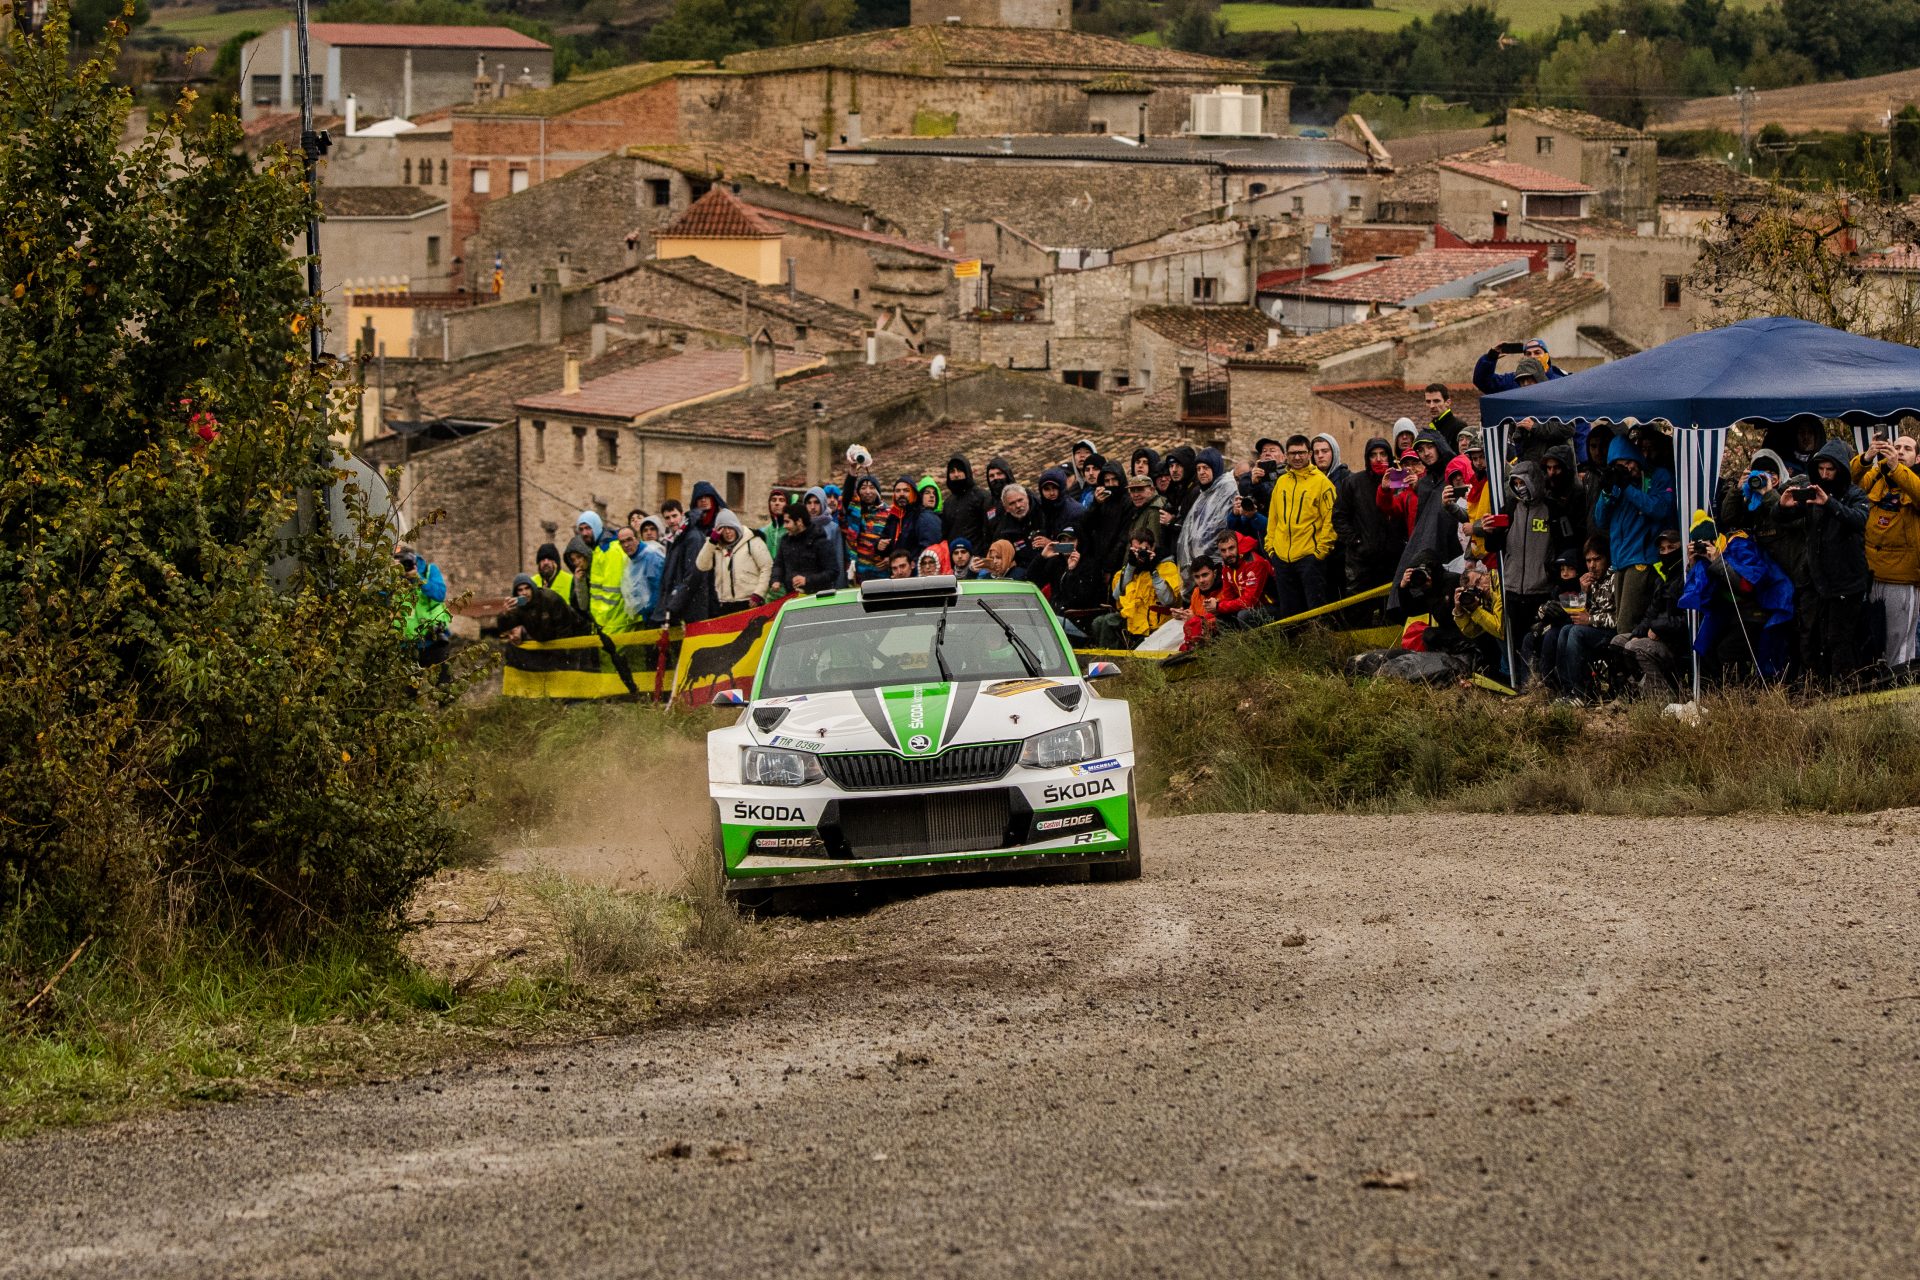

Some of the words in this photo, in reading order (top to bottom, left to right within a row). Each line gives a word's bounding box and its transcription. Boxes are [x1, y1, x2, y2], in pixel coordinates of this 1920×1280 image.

[908, 704, 924, 729] ŠKODA
[795, 740, 820, 751] 0390
[1087, 761, 1119, 770] MICHELIN
[1043, 778, 1116, 804] ŠKODA
[734, 800, 806, 822] ŠKODA
[1062, 814, 1094, 827] EDGE
[779, 837, 812, 847] EDGE
[1074, 830, 1108, 844] R5
